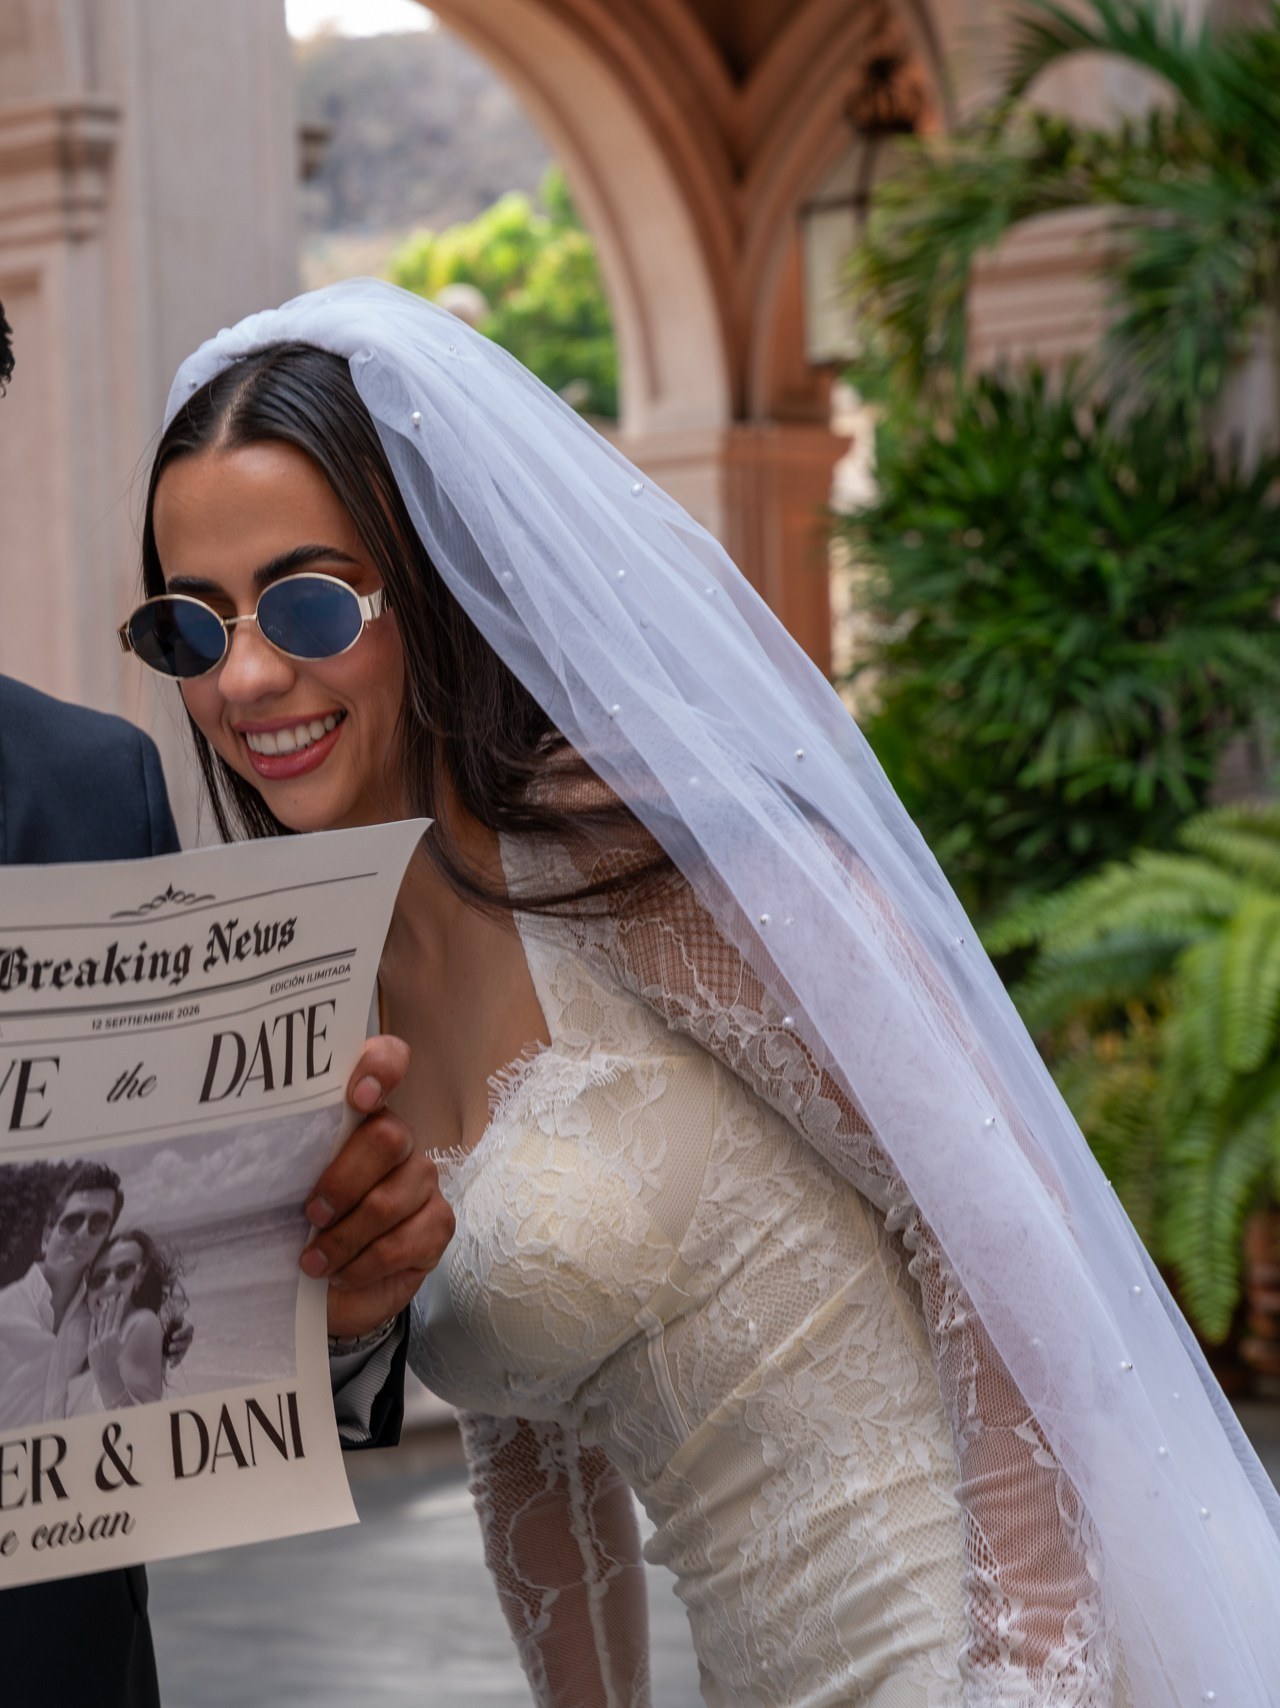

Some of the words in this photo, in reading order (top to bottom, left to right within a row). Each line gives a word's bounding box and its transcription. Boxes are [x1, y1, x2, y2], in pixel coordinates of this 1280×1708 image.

[202, 915, 299, 973] News
[269, 976, 305, 994] EDICIÓN
[306, 963, 351, 985] ILIMITADA
[91, 1019, 103, 1030] 12
[105, 1007, 175, 1029] SEPTIEMBRE
[176, 1004, 200, 1019] 2026
[106, 1061, 158, 1104] the
[198, 999, 337, 1104] DATE
[95, 1422, 144, 1493] &
[169, 1391, 306, 1480] DANI
[30, 1509, 136, 1552] casan
